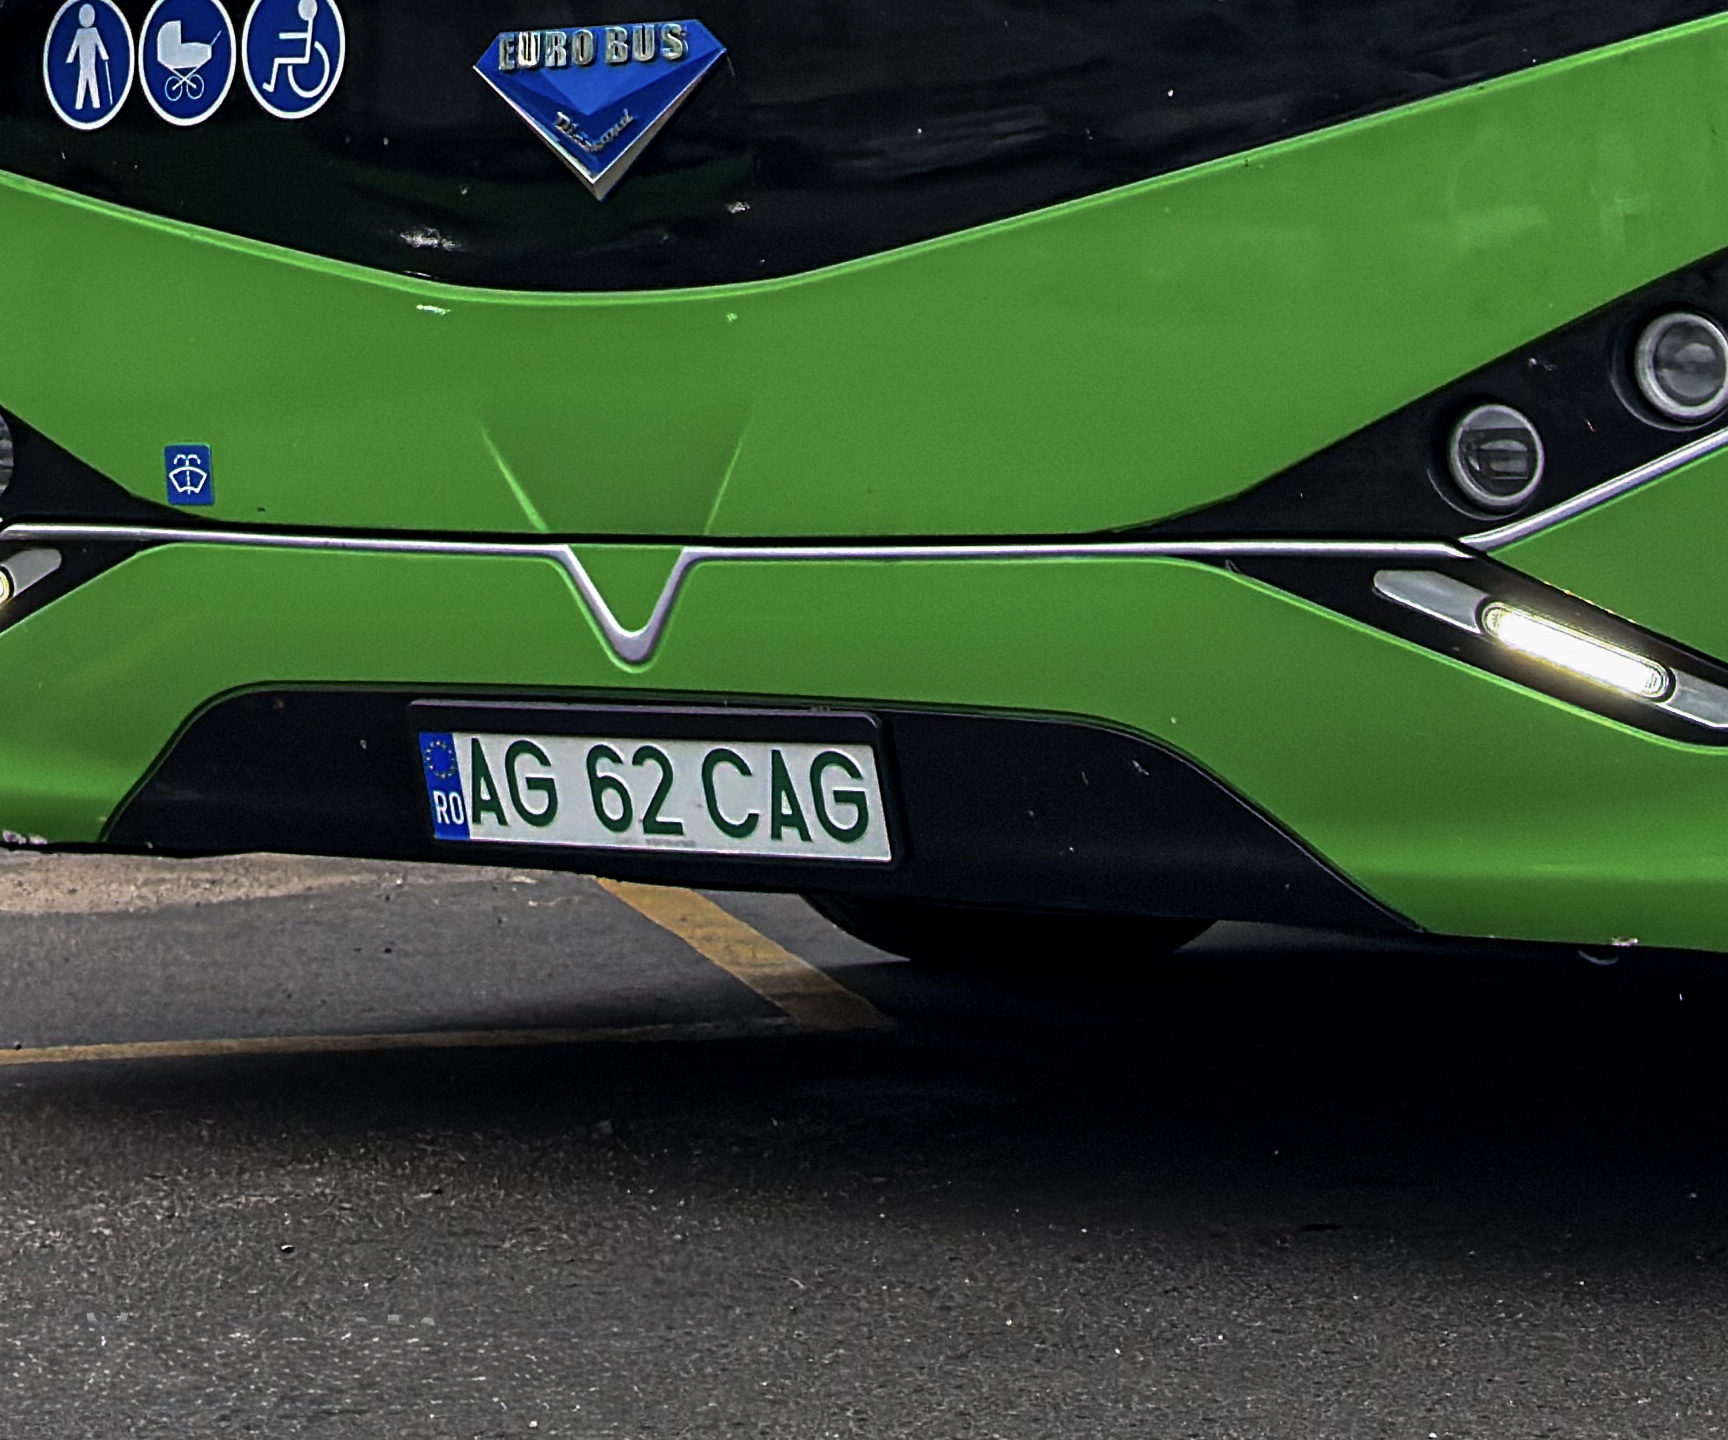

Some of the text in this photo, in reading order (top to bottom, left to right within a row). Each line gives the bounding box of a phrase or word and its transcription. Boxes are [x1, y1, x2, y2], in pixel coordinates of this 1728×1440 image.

[497, 21, 690, 72] EURO BUS
[432, 789, 466, 825] RO
[470, 736, 871, 844] AG 62 CAG
